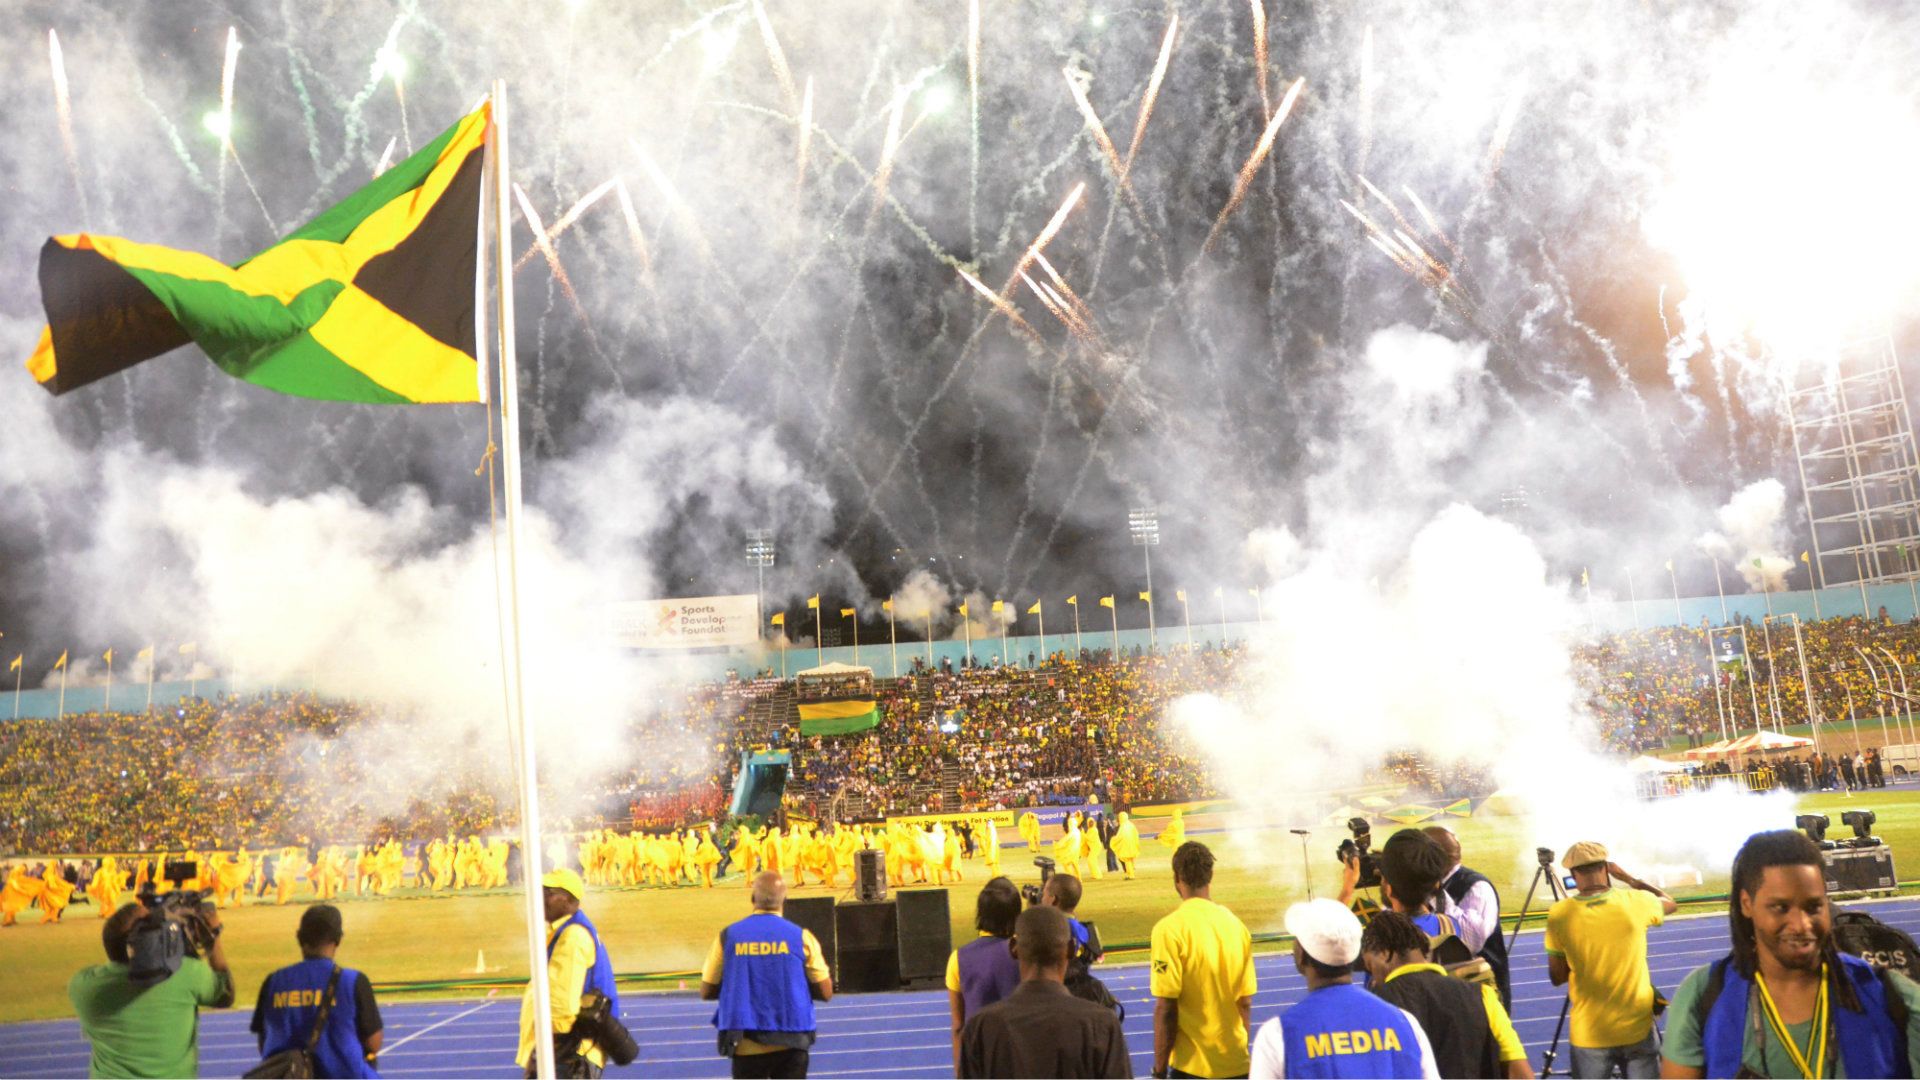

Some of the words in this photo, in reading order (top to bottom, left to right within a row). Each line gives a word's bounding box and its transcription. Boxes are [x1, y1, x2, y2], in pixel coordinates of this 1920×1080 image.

[681, 605, 716, 615] Sports
[735, 940, 789, 956] MEDIA
[1861, 950, 1907, 966] GCIS
[1304, 1027, 1402, 1059] MEDIA
